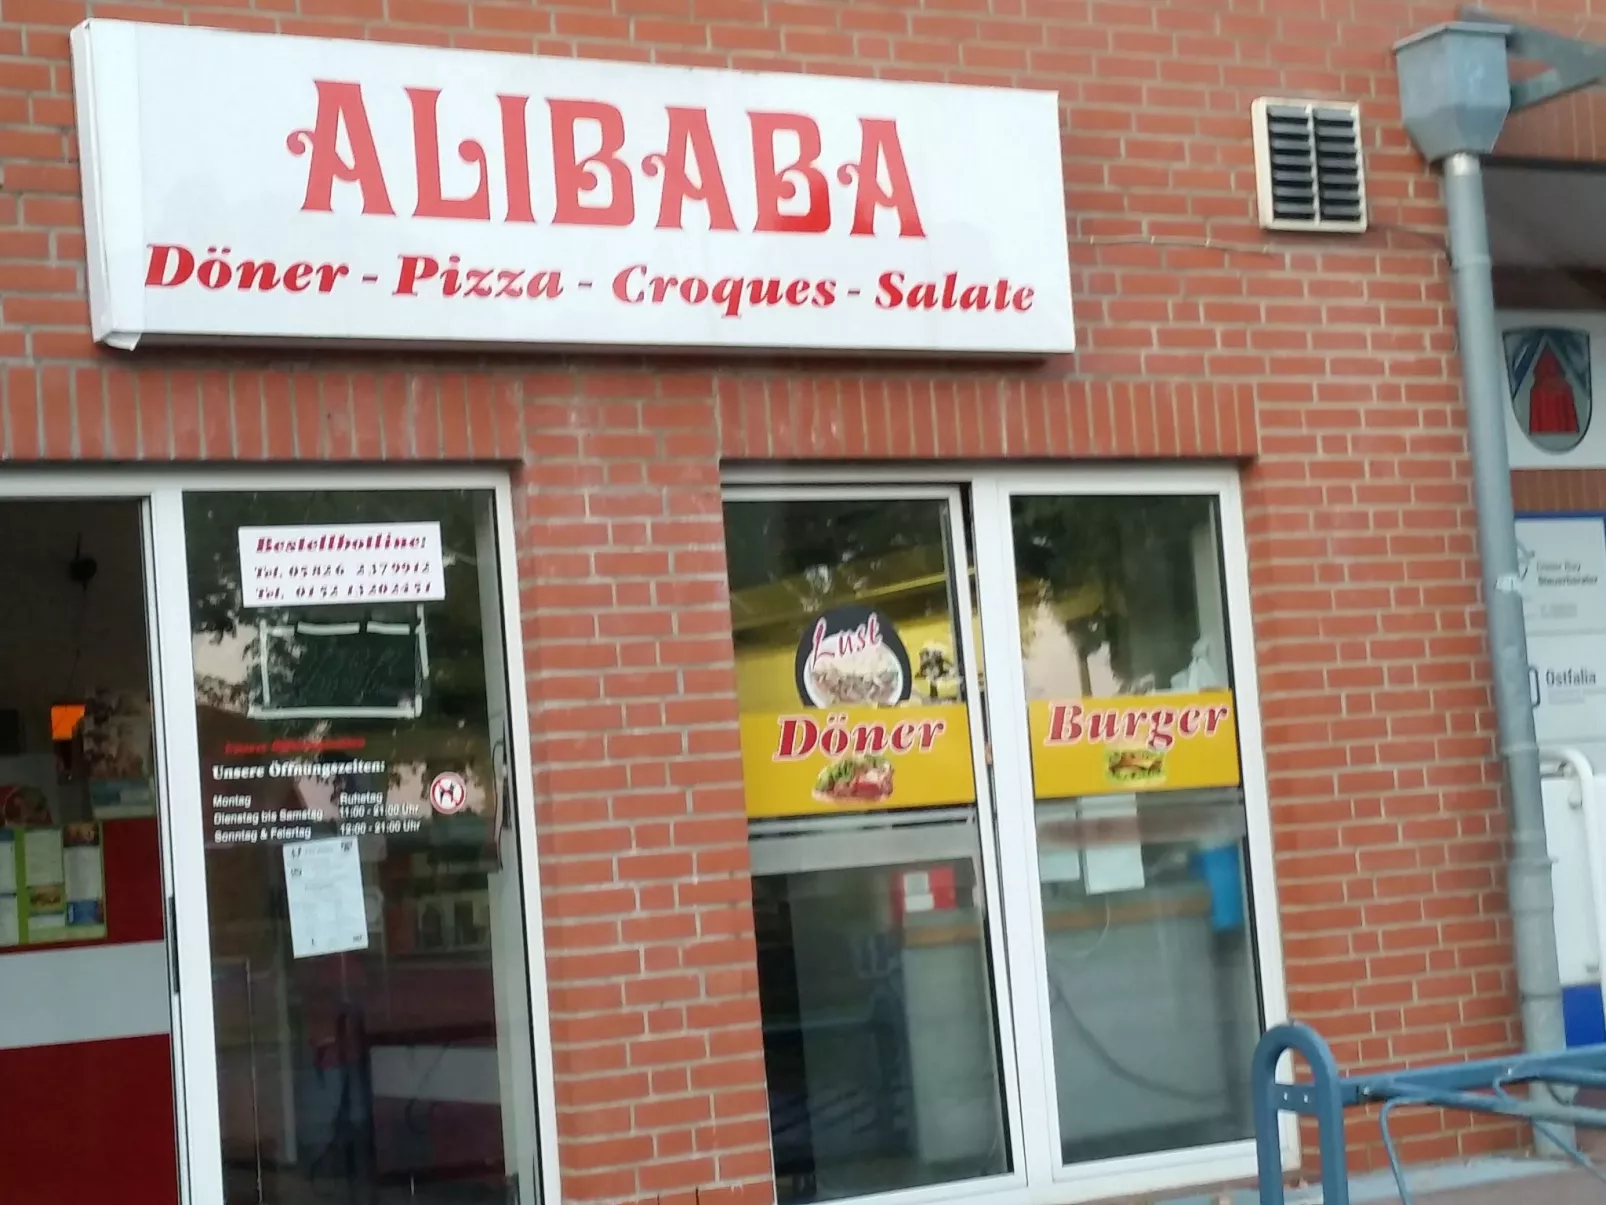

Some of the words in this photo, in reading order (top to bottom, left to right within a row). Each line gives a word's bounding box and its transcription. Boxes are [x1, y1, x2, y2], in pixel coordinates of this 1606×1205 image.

[286, 79, 927, 239] ALIBABA
[145, 243, 350, 294] Döner
[392, 254, 563, 299] Pizza
[611, 264, 837, 318] Croques
[874, 270, 1035, 312] Salate
[812, 612, 883, 671] Lust
[773, 712, 946, 763] Döner
[1045, 699, 1228, 750] Burger
[212, 764, 265, 780] Unsere
[213, 794, 252, 809] Montag
[401, 802, 420, 816] Uhr
[403, 819, 421, 832] Uhr
